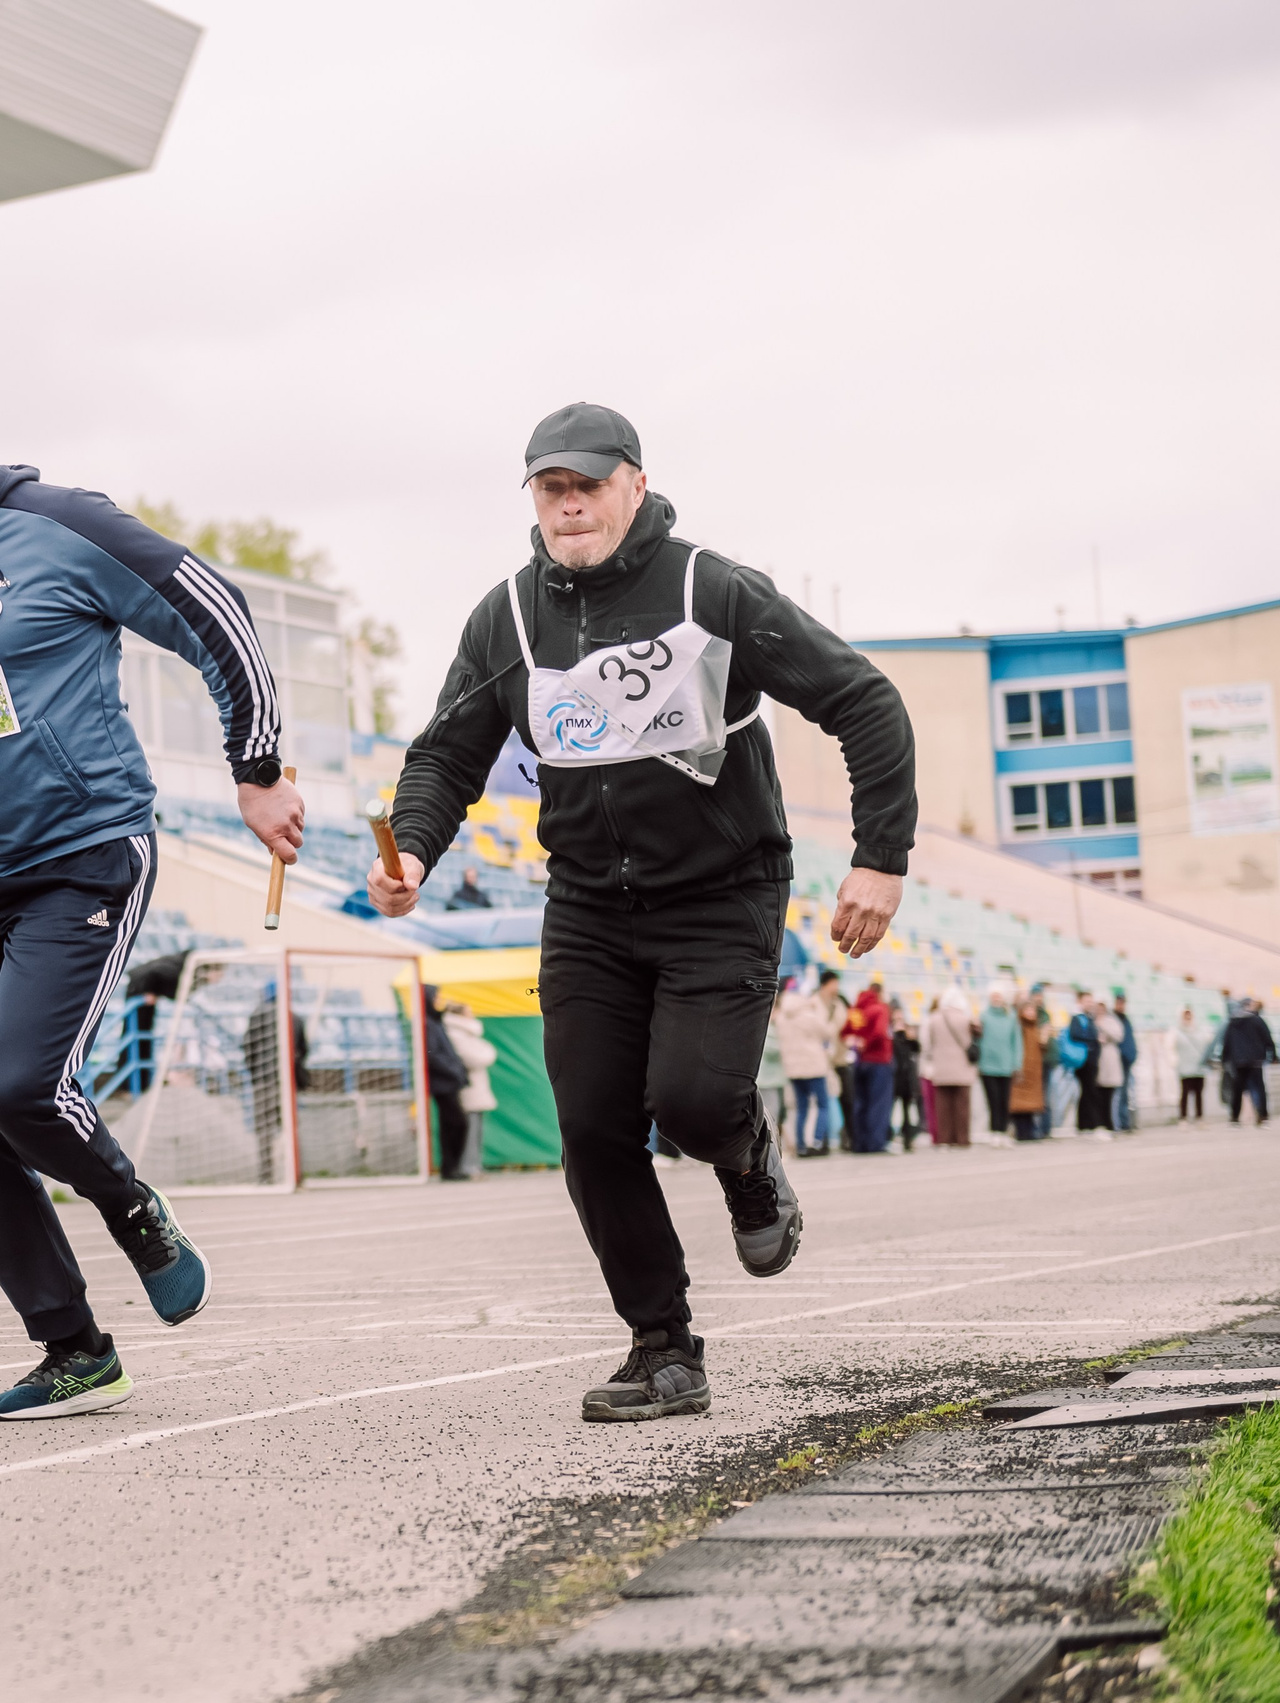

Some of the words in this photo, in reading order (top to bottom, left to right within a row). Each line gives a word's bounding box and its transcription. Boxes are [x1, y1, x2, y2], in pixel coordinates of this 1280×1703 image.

[599, 639, 673, 702] 39
[565, 717, 593, 729] ПМХ
[87, 917, 109, 927] adidas
